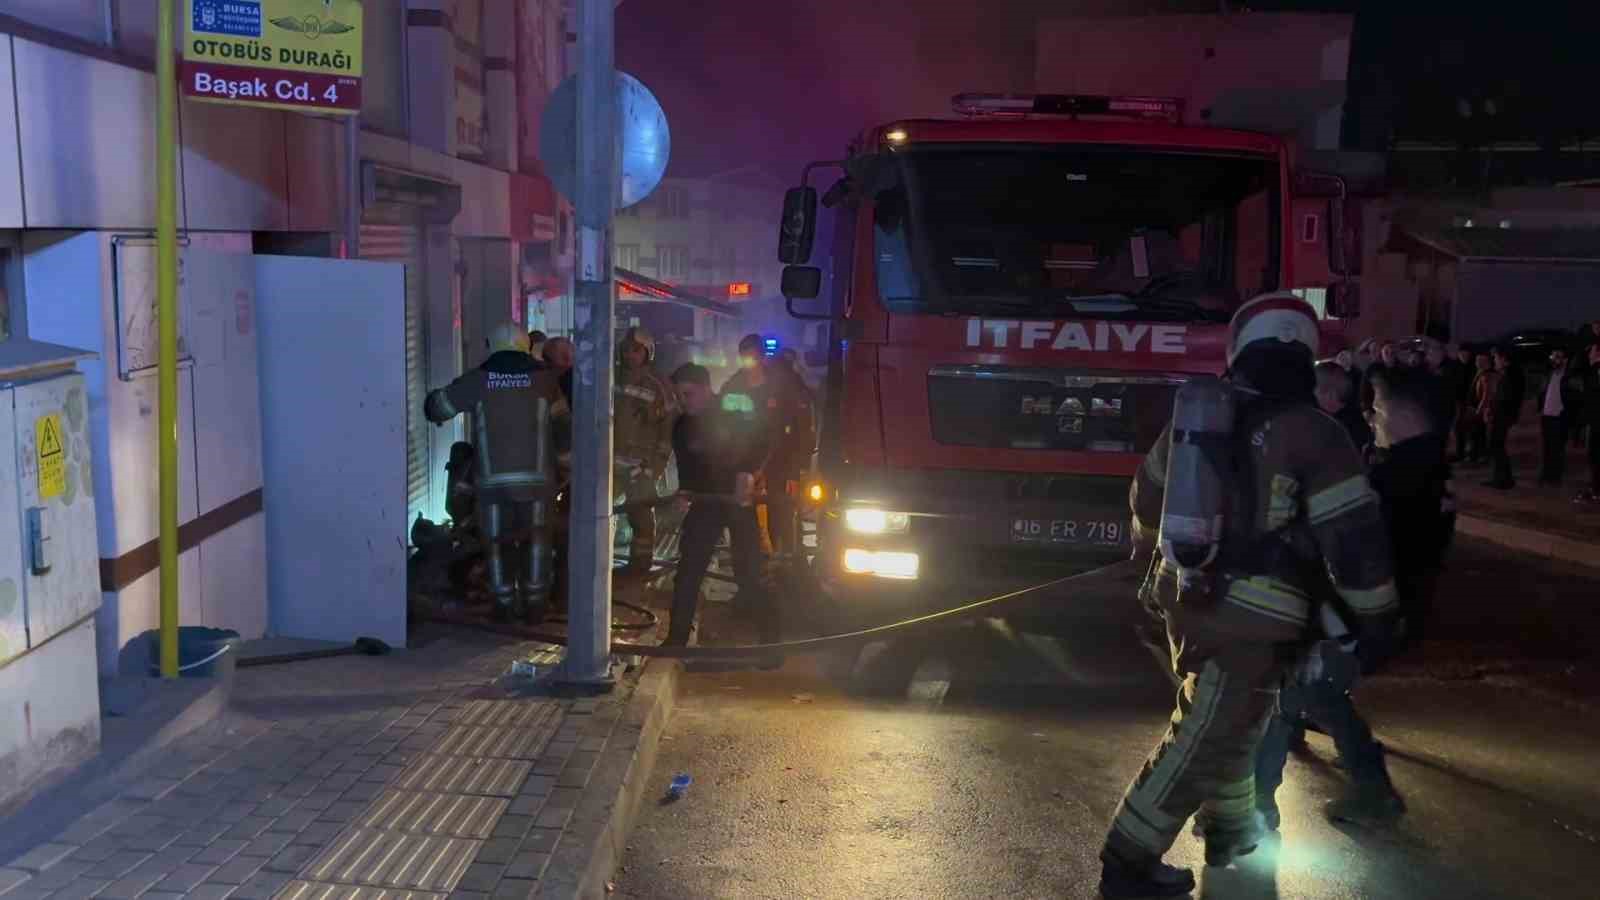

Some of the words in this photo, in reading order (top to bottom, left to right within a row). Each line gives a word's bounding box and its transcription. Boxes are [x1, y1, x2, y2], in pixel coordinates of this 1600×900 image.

[193, 40, 272, 62] OTOBÜS
[279, 48, 351, 70] DURAĞI
[194, 72, 268, 99] Başak
[275, 79, 316, 101] Cd.
[323, 83, 338, 103] 4
[1087, 521, 1118, 539] 719
